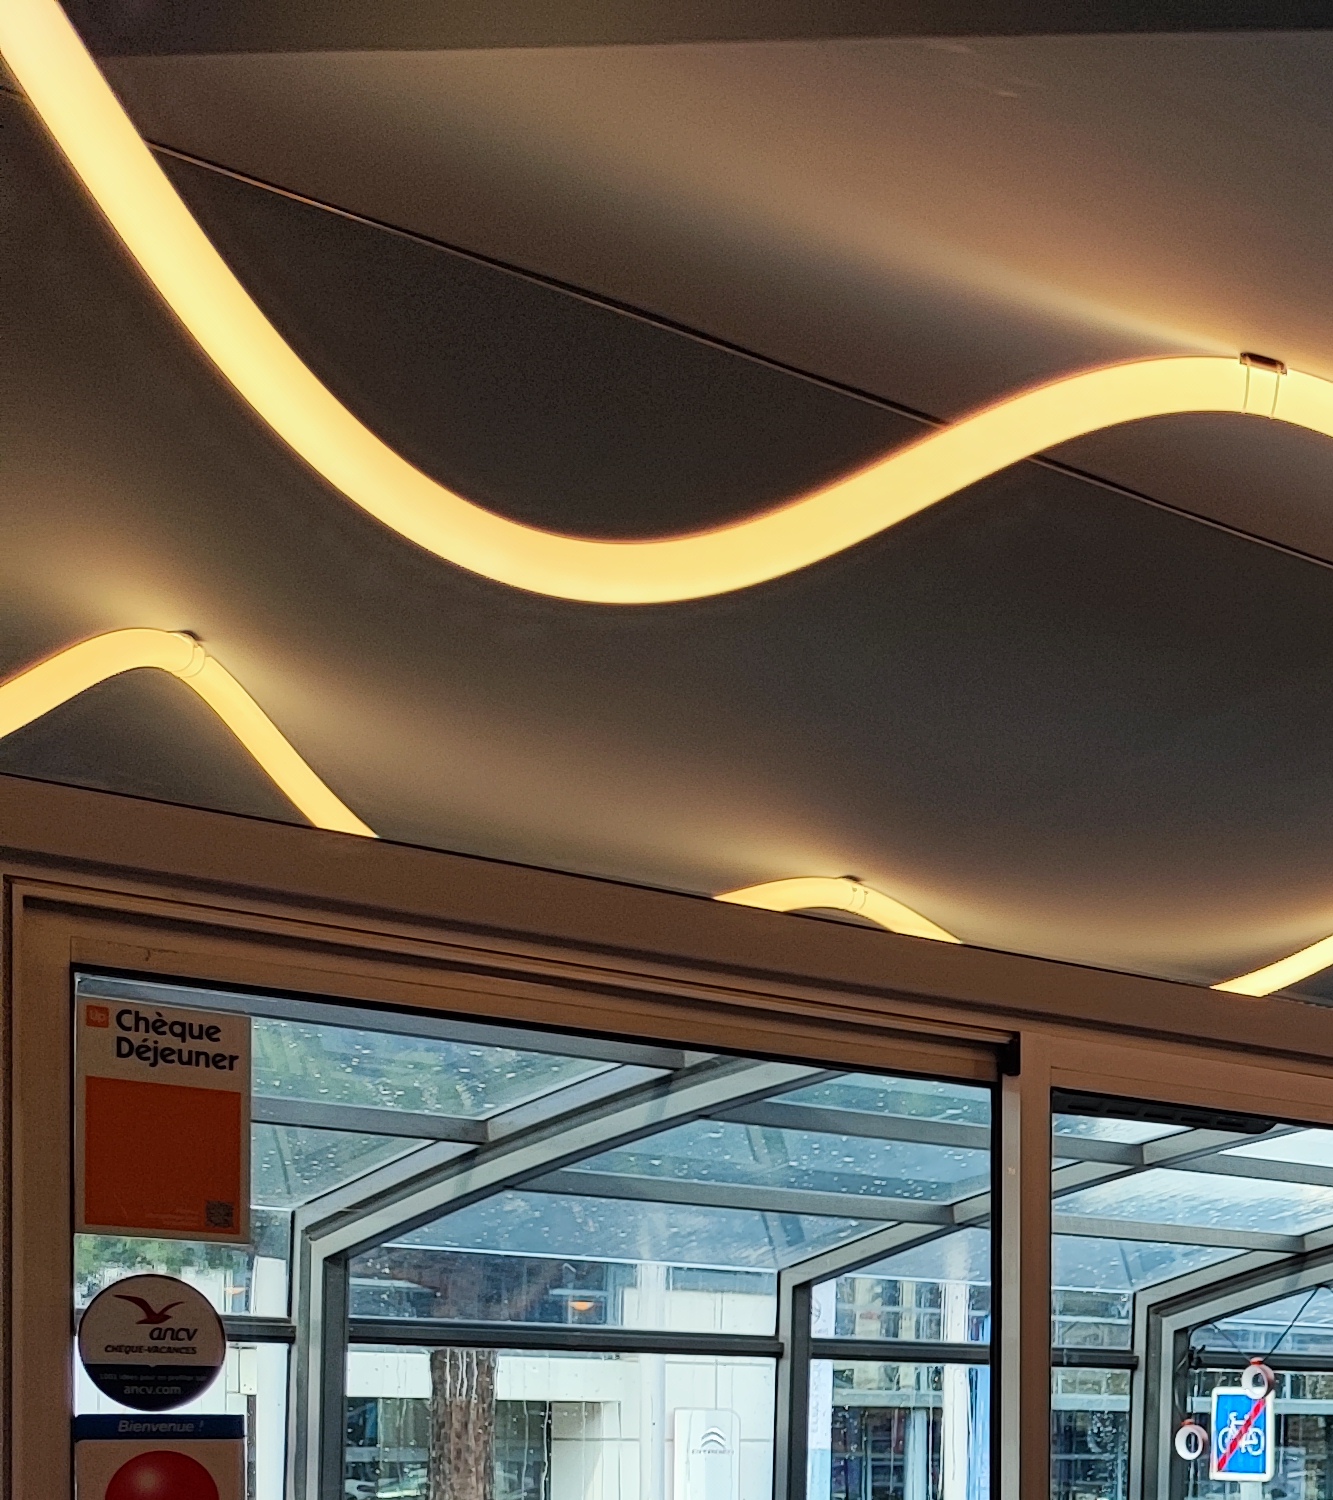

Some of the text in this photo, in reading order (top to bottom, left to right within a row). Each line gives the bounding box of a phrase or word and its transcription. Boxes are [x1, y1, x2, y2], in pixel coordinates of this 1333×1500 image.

[115, 1009, 222, 1043] Chèque
[115, 1036, 240, 1070] Déjeuner
[149, 1327, 198, 1341] ancv
[123, 1385, 182, 1395] ancv.com
[117, 1420, 195, 1432] Bienvenue
